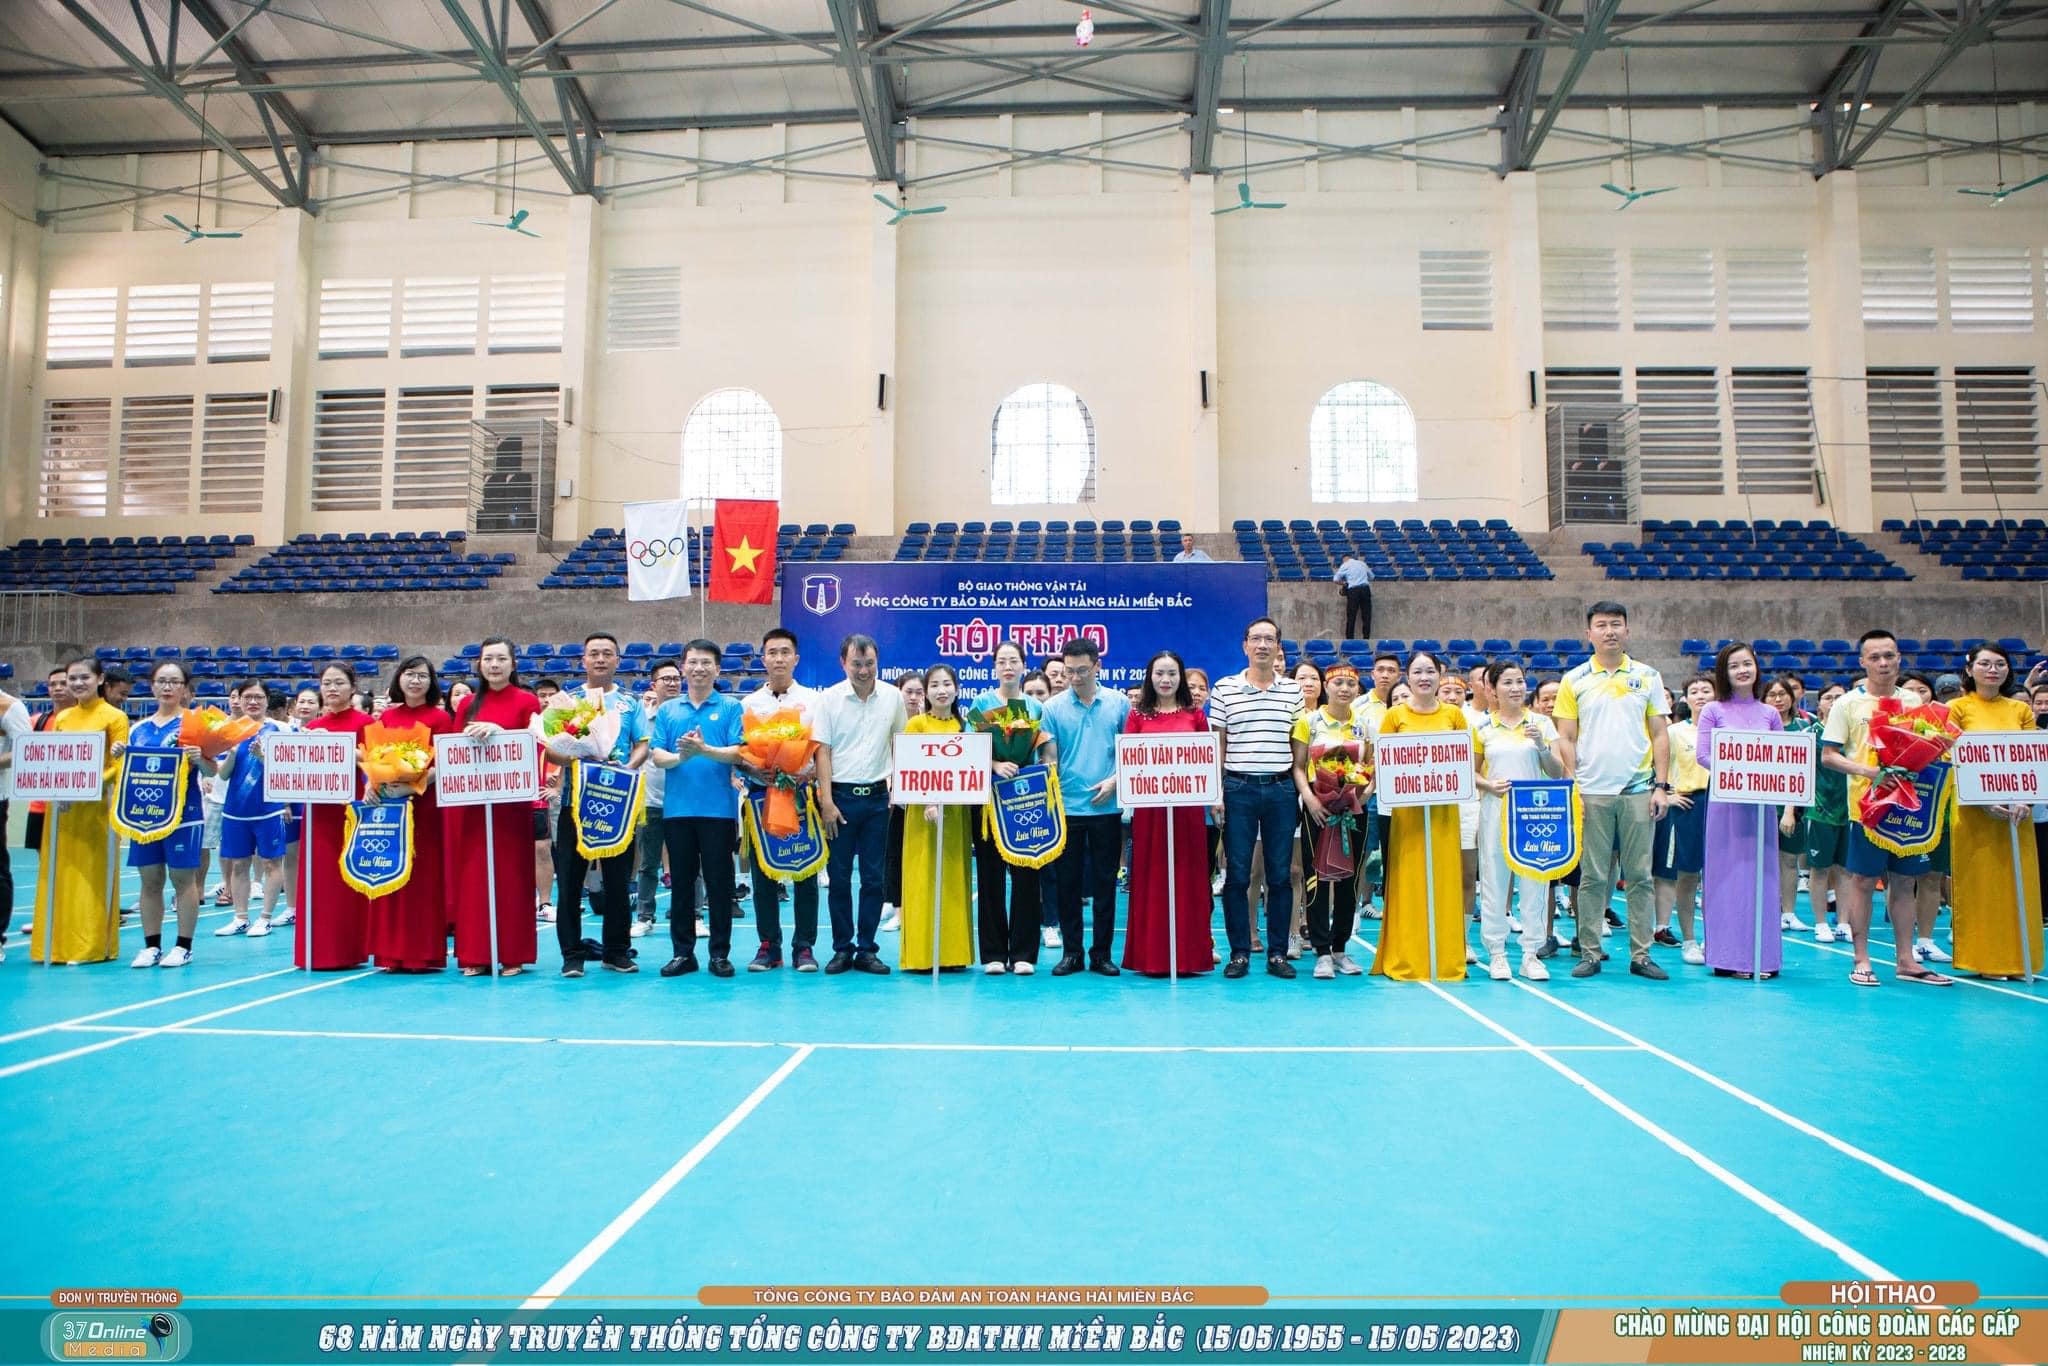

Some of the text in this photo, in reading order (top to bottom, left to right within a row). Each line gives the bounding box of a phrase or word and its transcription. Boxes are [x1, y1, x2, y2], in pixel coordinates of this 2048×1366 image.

[958, 580, 973, 592] BỘ
[975, 582, 1003, 591] GIAO
[1005, 580, 1043, 592] THÔNG
[854, 592, 889, 608] TỔNG
[892, 594, 928, 608] CÔNG
[931, 597, 948, 607] TY
[951, 593, 977, 608] BẢO
[1010, 597, 1028, 608] AN
[1031, 595, 1066, 608] TOÀN
[1069, 595, 1105, 608] HÀNG
[1167, 592, 1192, 608] BẮC
[936, 617, 1109, 662] HỘI THAO
[959, 666, 988, 680] CÔNG
[24, 742, 93, 761] CÔNG TY HOA TIÊU
[274, 742, 345, 763] CÔNG TY HOA TIÊU
[447, 741, 522, 765] CÔNG TY HOA TIÊU
[921, 736, 963, 757] TỔ
[1122, 742, 1213, 765] KHỐI VĂN PHÒNG
[1380, 742, 1468, 768] XÍ NGHIỆP BĐATHH
[1719, 736, 1807, 765] BẢO ĐẢM ATHH
[1958, 741, 1990, 763] CÔNG
[1992, 744, 2006, 762] TY
[54, 772, 69, 788] KHU
[72, 772, 87, 792] VỰC
[88, 771, 97, 788] III
[270, 769, 290, 791] HÀNG
[307, 773, 322, 790] KHU
[324, 773, 340, 795] VỰC
[341, 774, 349, 792] VI
[468, 768, 482, 792] HẢI
[484, 774, 500, 792] KHU
[504, 772, 521, 794] VỰC
[523, 771, 531, 790] IV
[900, 765, 984, 796] TRỌNG TÀI
[1130, 770, 1207, 795] TỔNG CÔNG TY
[1395, 768, 1459, 795] ĐÔNG BẮC BỘ
[1719, 766, 1805, 797] BẮC TRUNG BỘ
[1980, 769, 2038, 795] TRUNG BỘ
